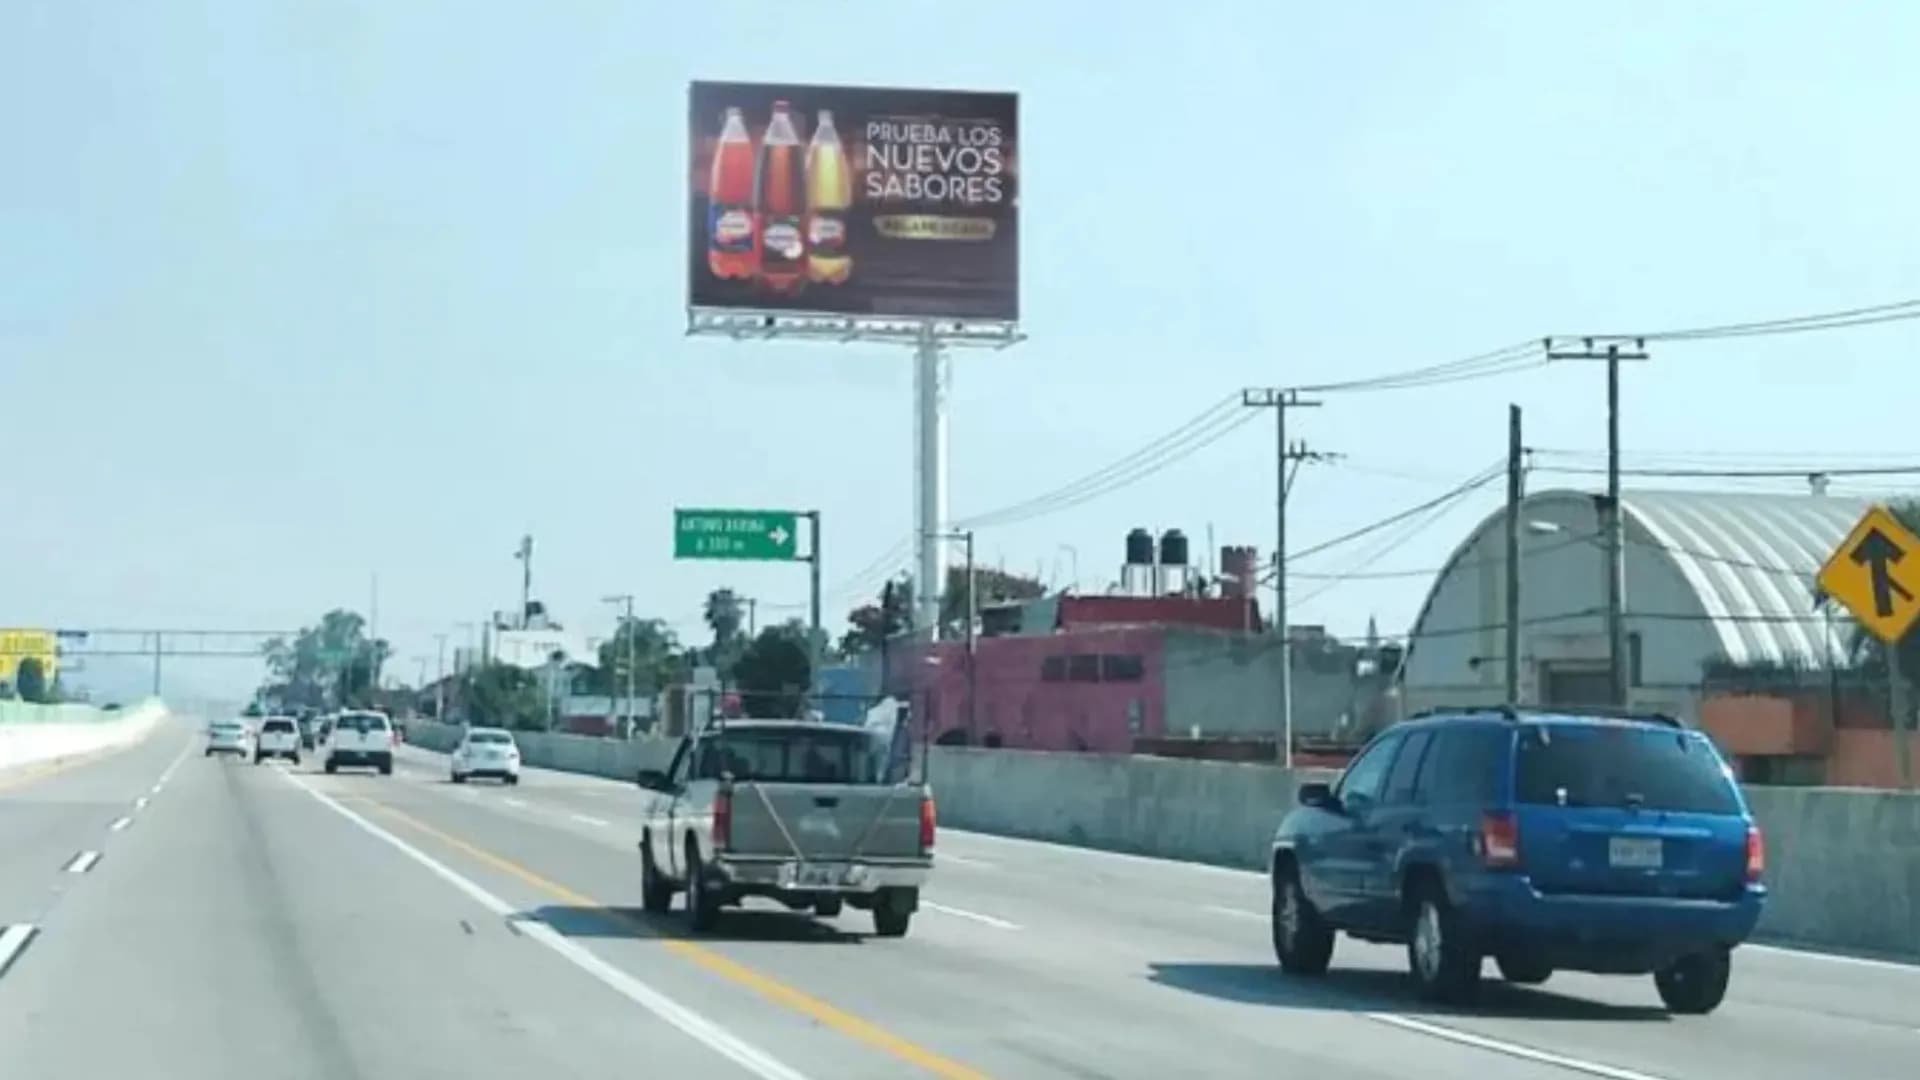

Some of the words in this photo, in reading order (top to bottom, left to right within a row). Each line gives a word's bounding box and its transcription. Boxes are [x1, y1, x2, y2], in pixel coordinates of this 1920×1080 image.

[866, 122, 952, 143] PRUEBA
[957, 126, 1002, 147] LOS
[866, 144, 1002, 175] NUEVOS
[866, 171, 1003, 202] SABORES
